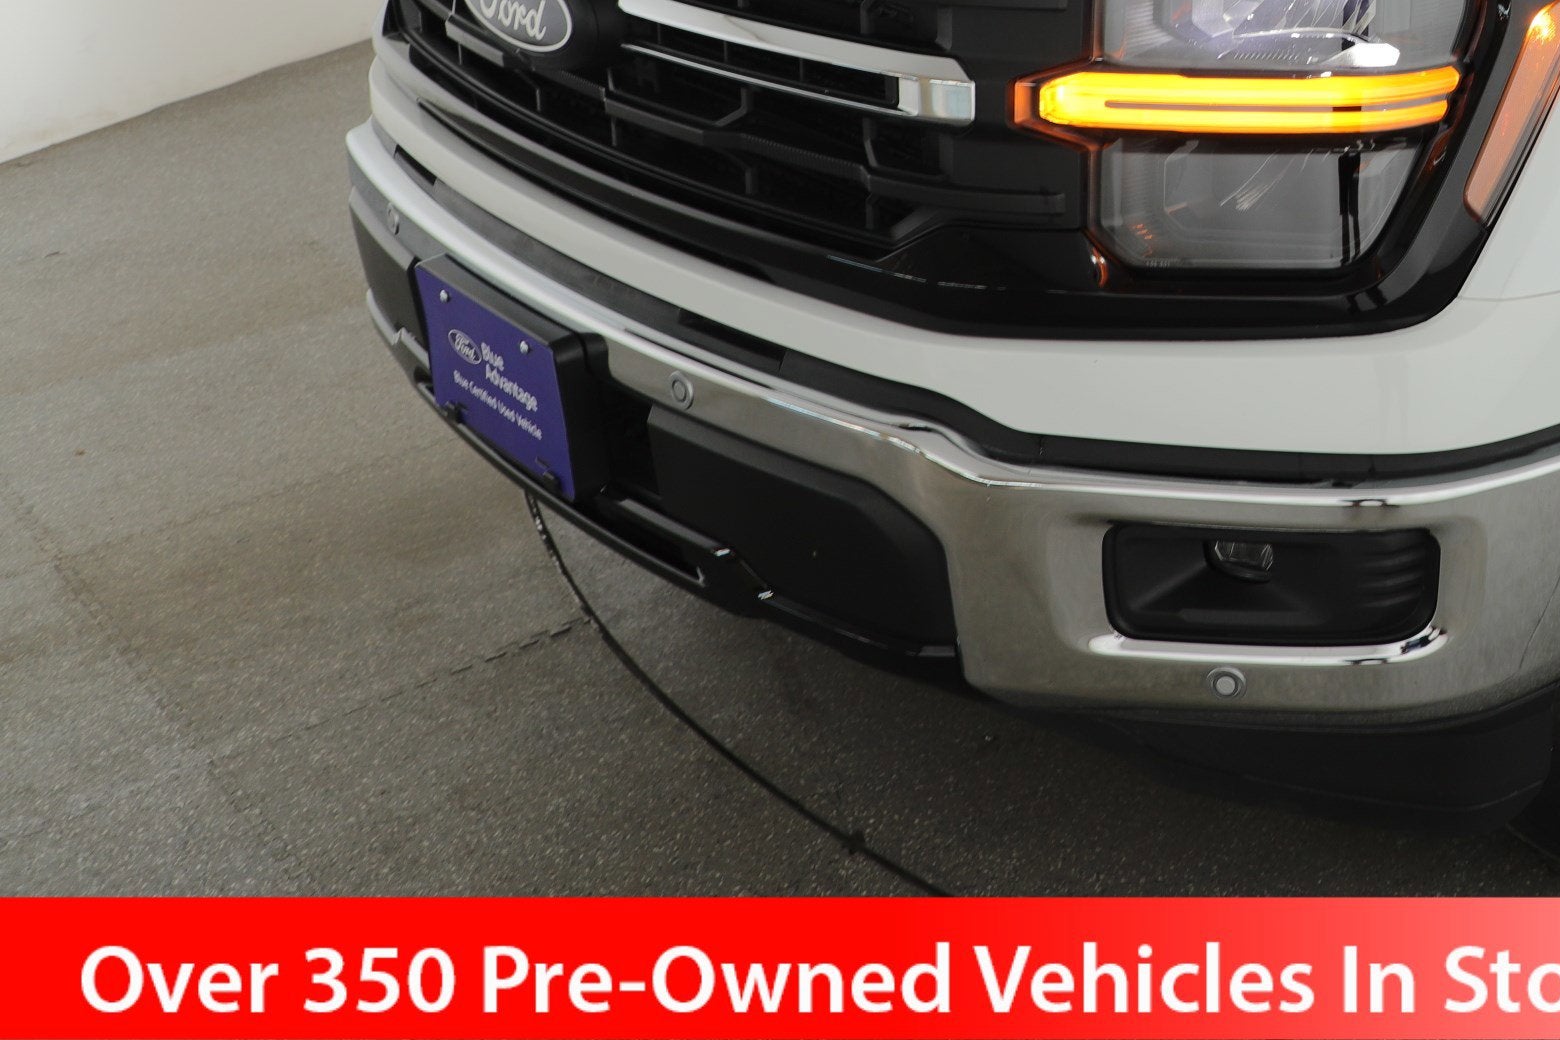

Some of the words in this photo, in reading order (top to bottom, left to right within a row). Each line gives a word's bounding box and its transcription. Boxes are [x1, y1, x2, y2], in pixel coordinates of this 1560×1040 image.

[455, 333, 477, 362] Ford
[481, 342, 504, 371] Blue
[453, 370, 469, 390] Blue
[469, 381, 497, 410] Certified
[498, 400, 515, 422] Used
[516, 412, 542, 440] Vehicle
[485, 363, 538, 412] Advantage
